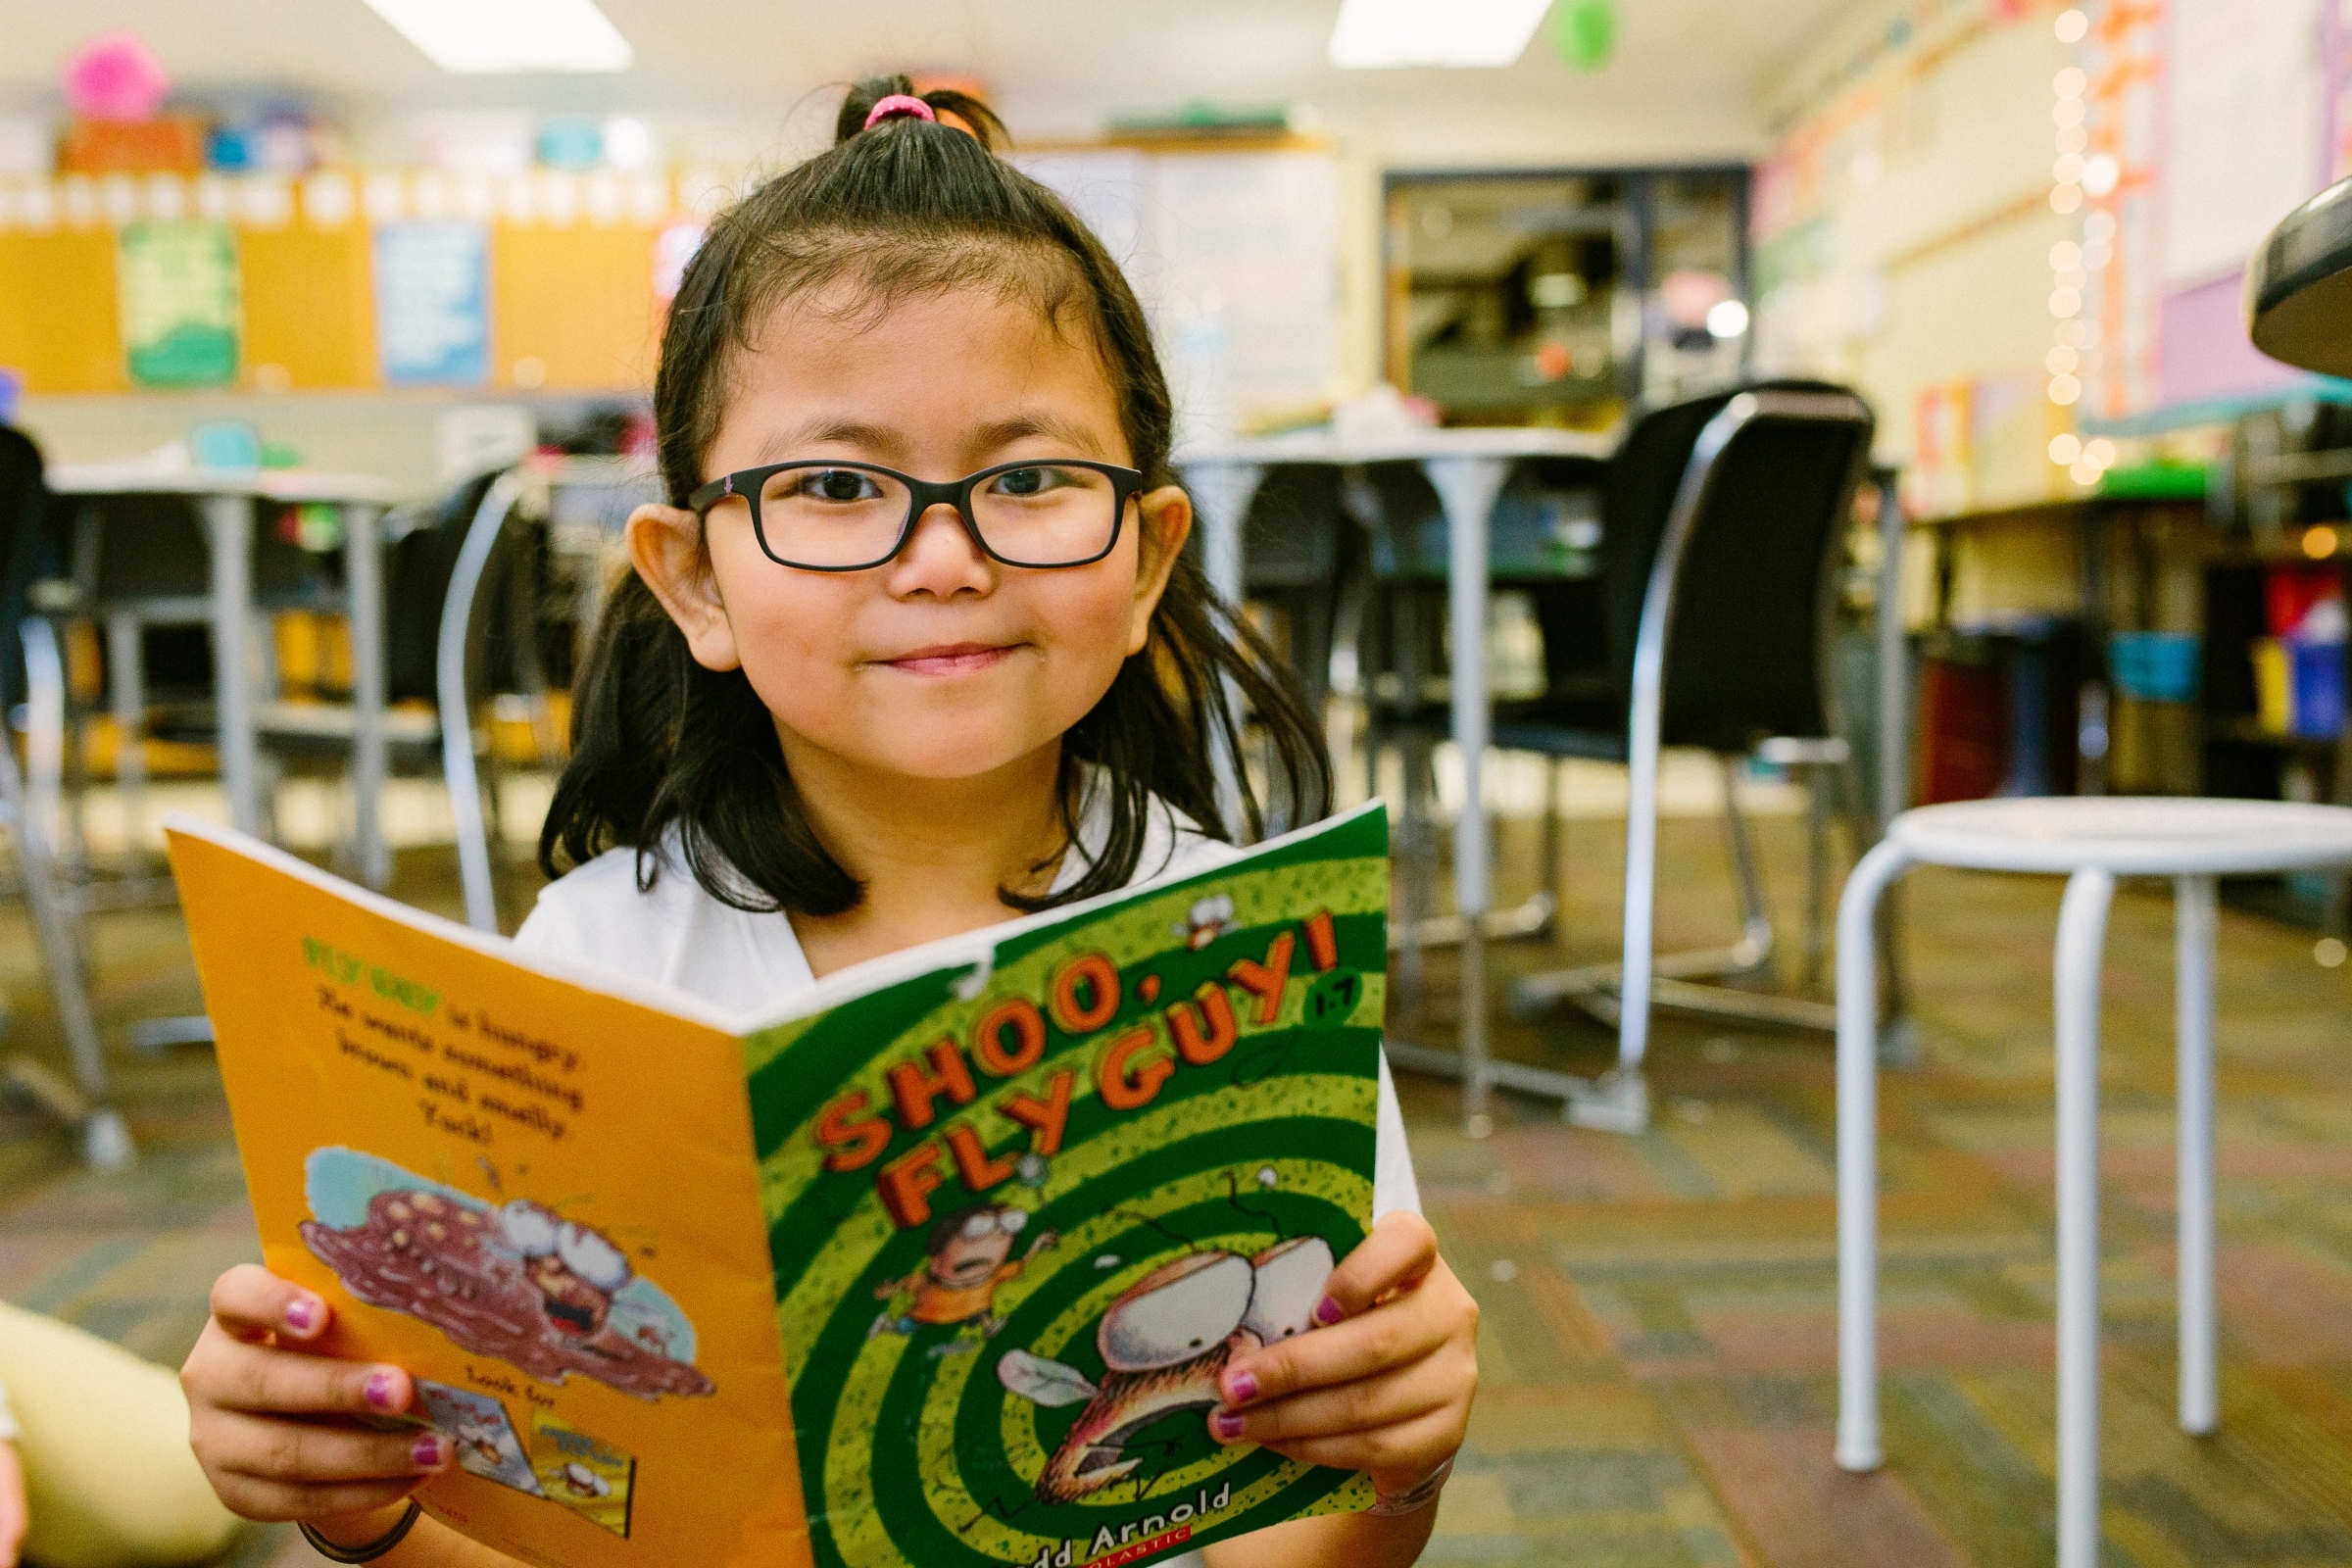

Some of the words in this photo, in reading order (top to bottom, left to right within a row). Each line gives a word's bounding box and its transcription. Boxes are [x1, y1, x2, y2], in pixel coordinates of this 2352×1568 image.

[811, 955, 1162, 1172] SHOO,
[875, 1066, 1074, 1228] FLY
[1096, 908, 1340, 1109] GUY!
[1090, 1481, 1231, 1555] Arnold
